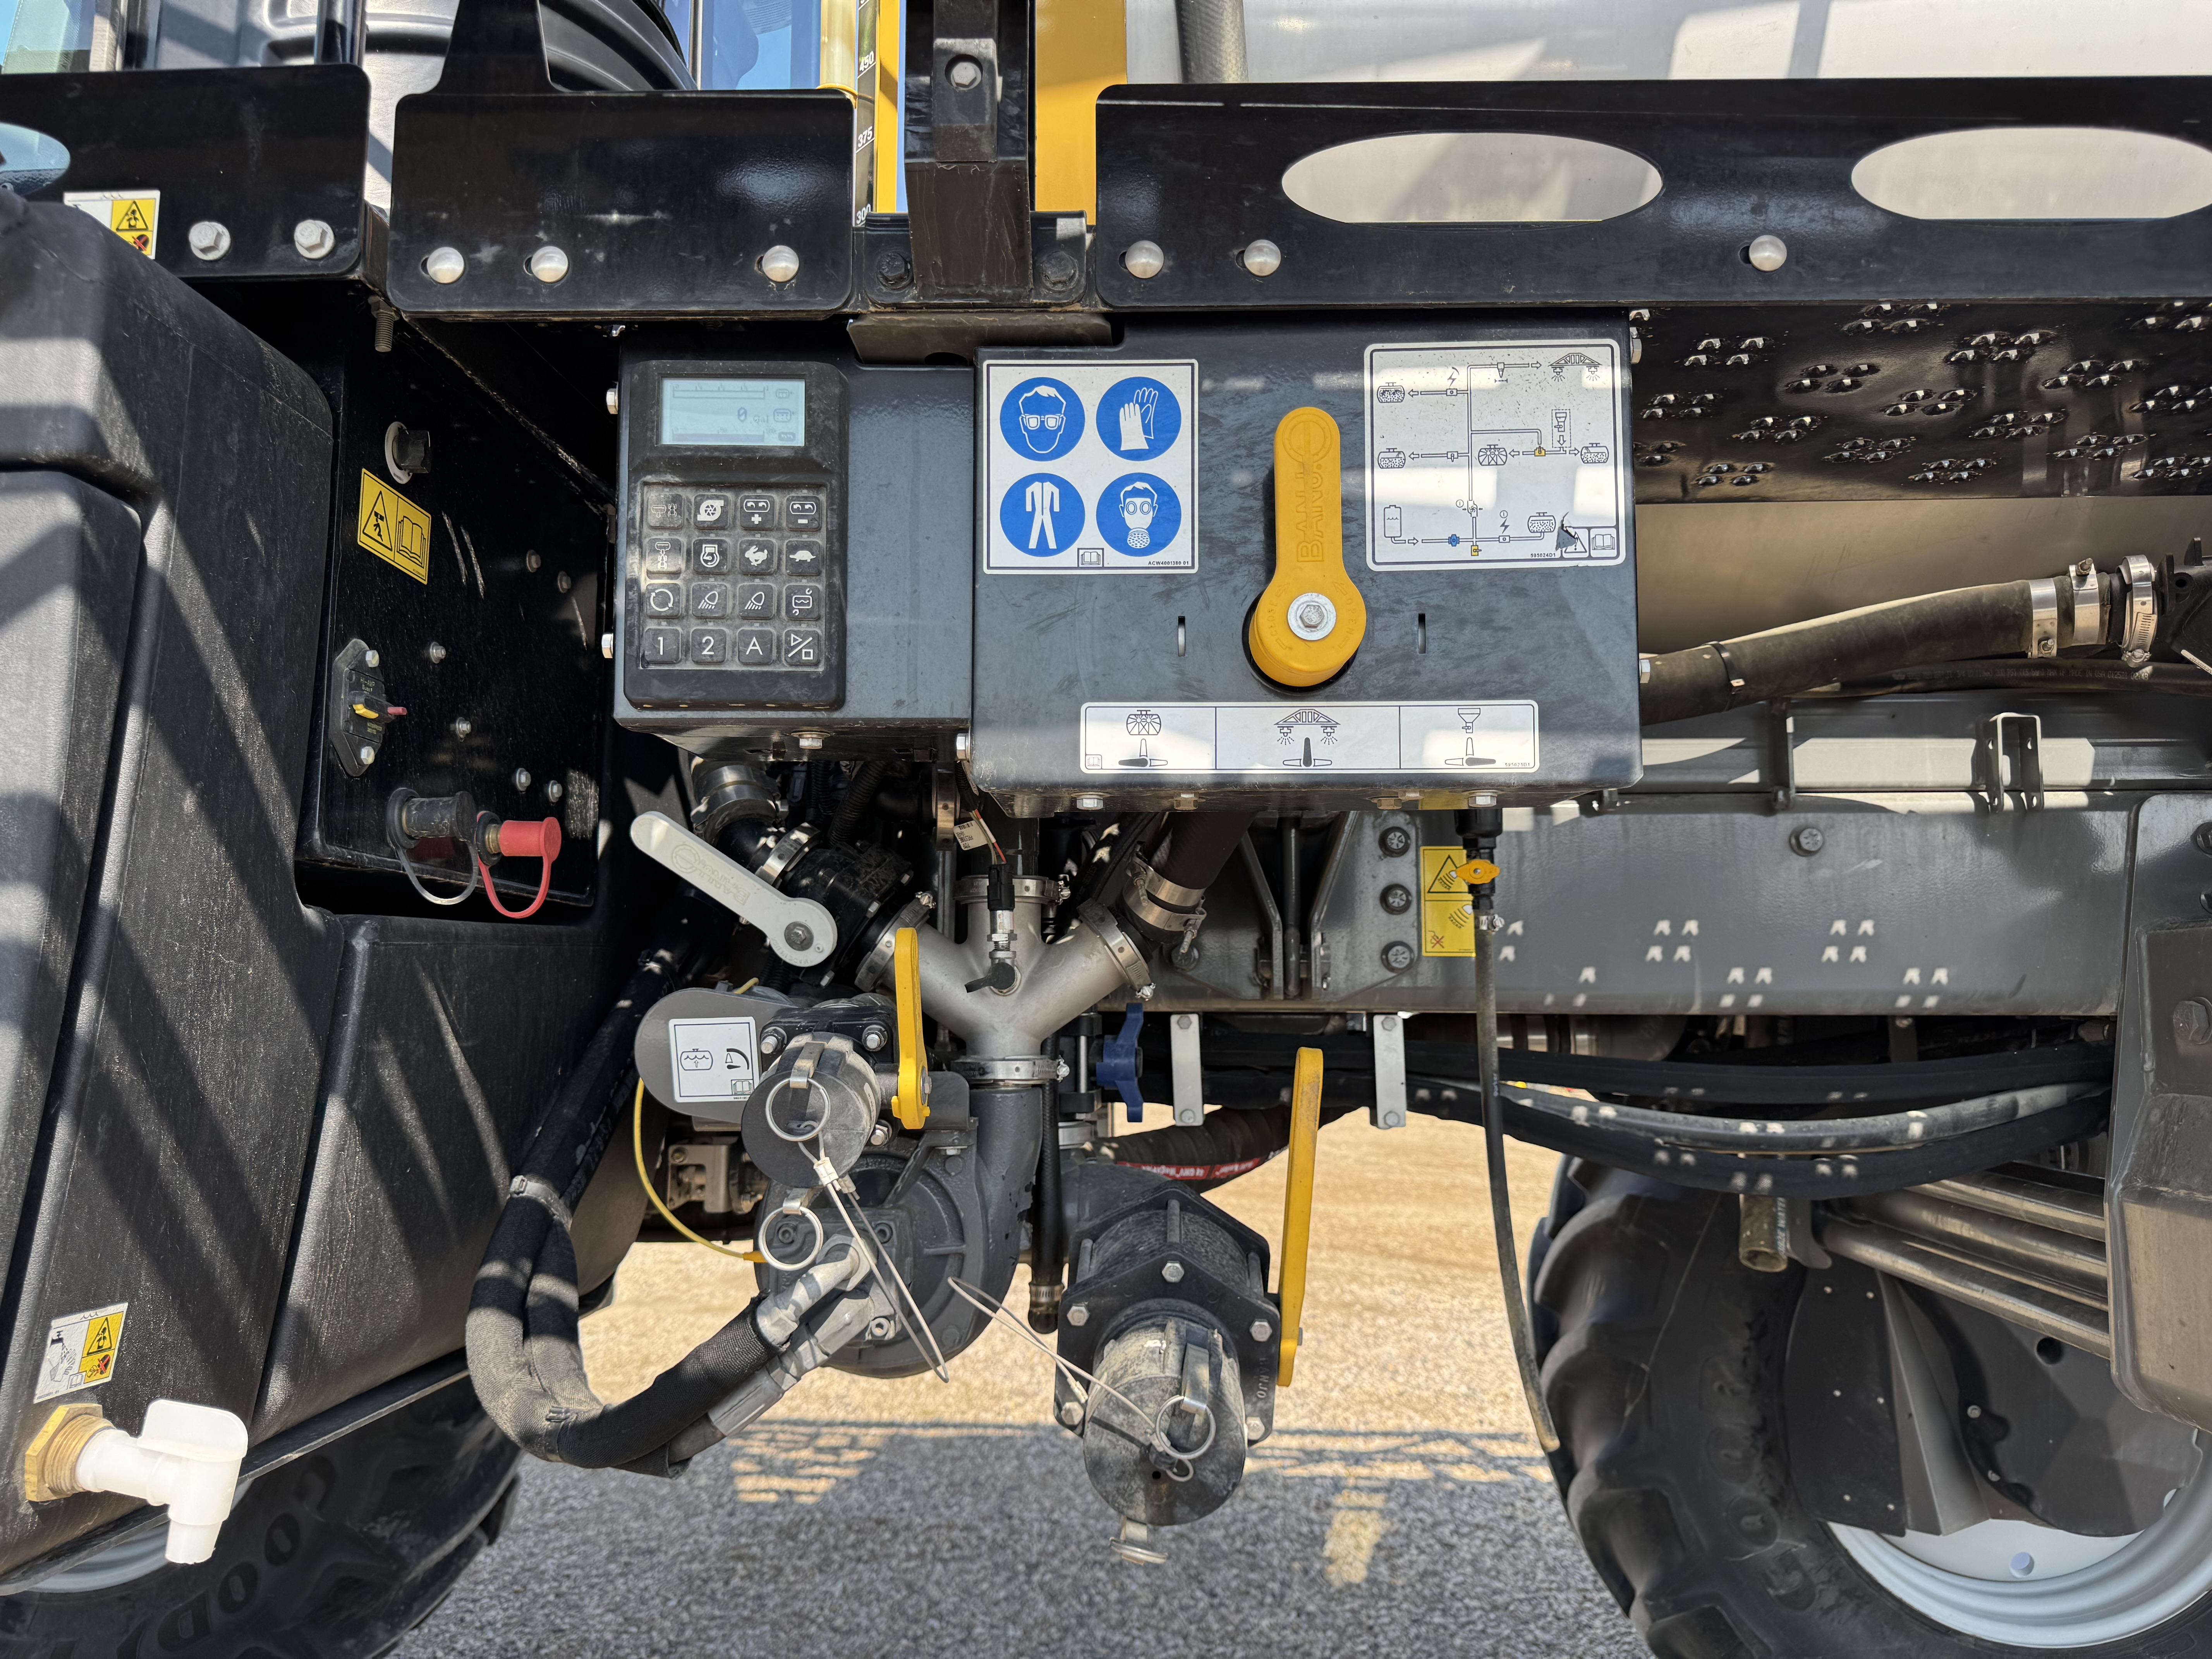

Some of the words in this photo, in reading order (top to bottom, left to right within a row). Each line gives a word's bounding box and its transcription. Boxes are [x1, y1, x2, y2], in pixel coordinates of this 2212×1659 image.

[859, 51, 874, 72] 450
[858, 126, 873, 148] 375
[737, 407, 747, 422] 0
[658, 637, 663, 655] 1
[701, 636, 714, 655] 2
[746, 636, 763, 655] A
[2095, 670, 2106, 678] USA
